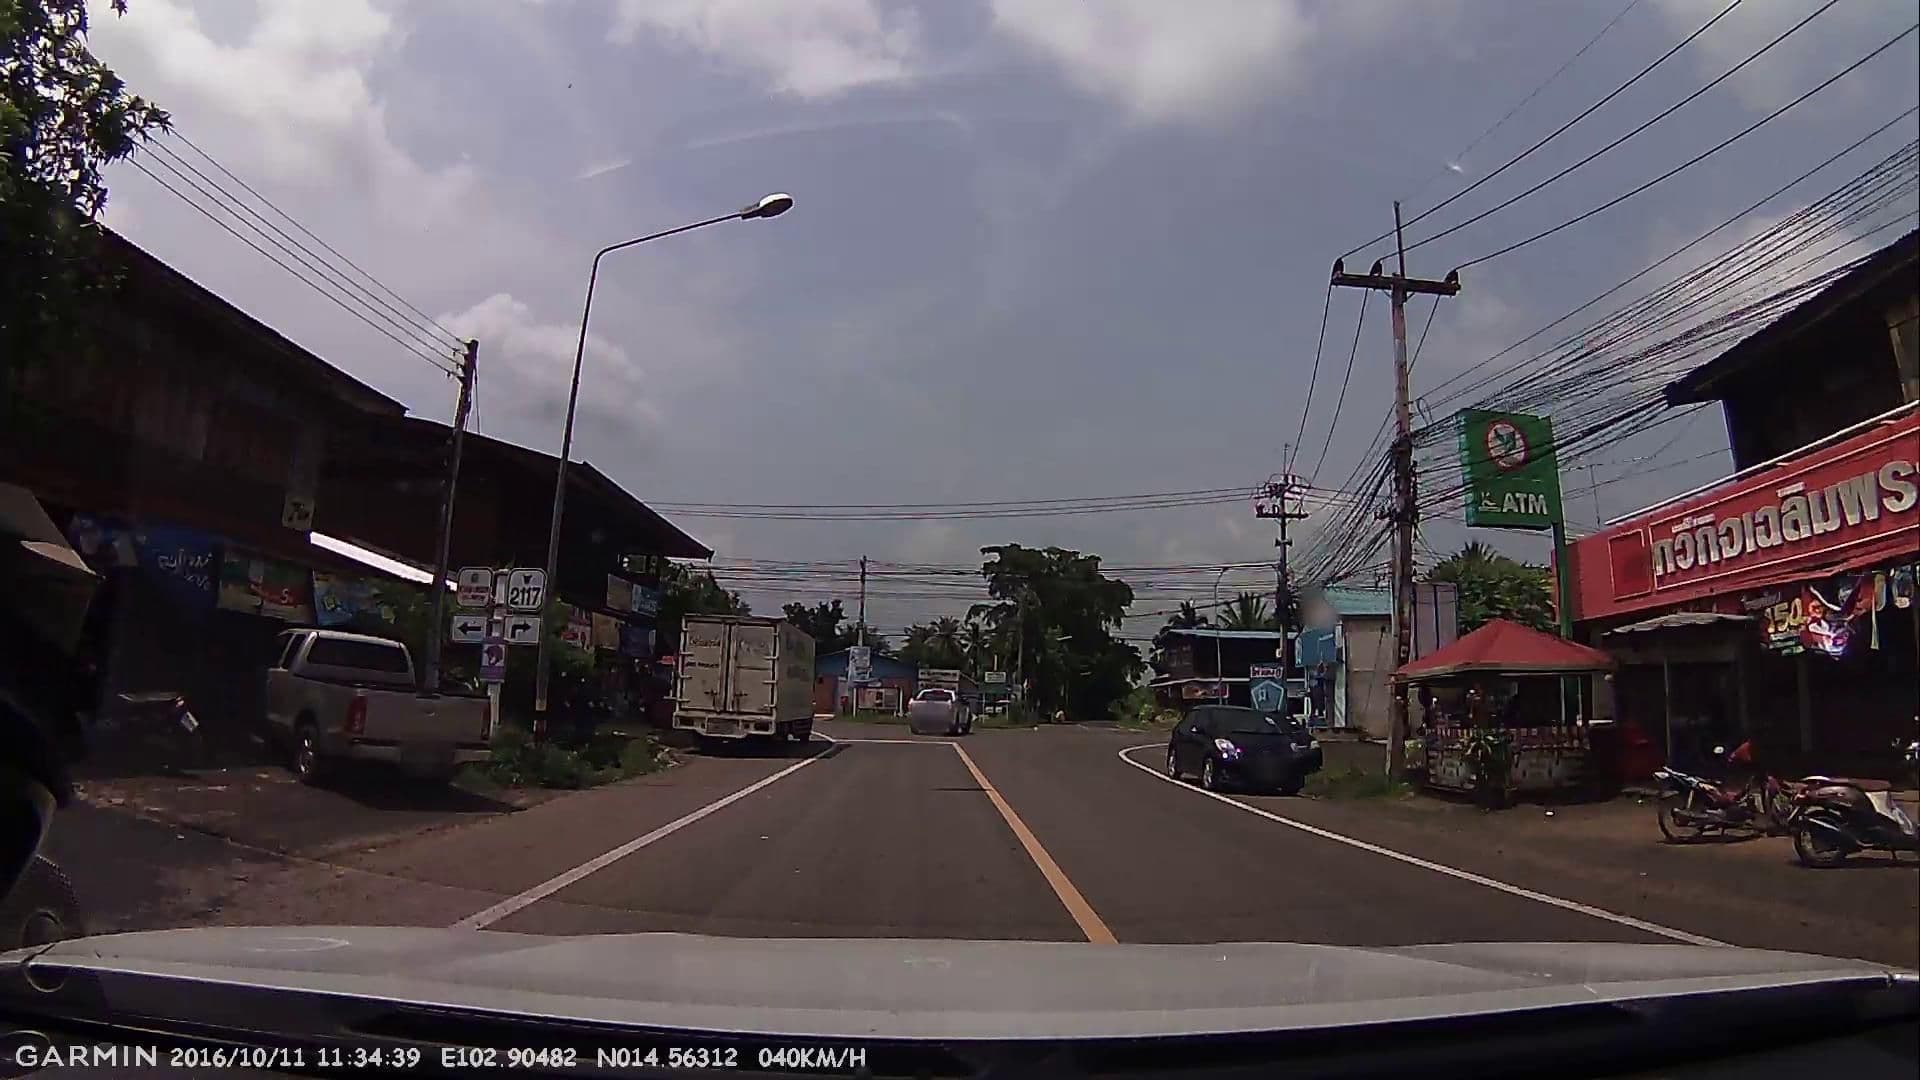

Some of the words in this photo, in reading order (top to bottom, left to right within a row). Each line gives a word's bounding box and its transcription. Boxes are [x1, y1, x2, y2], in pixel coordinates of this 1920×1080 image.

[1502, 492, 1548, 515] ATM
[1652, 459, 1919, 577] ทวีกิจเฉลิมพร
[510, 587, 541, 605] 2117
